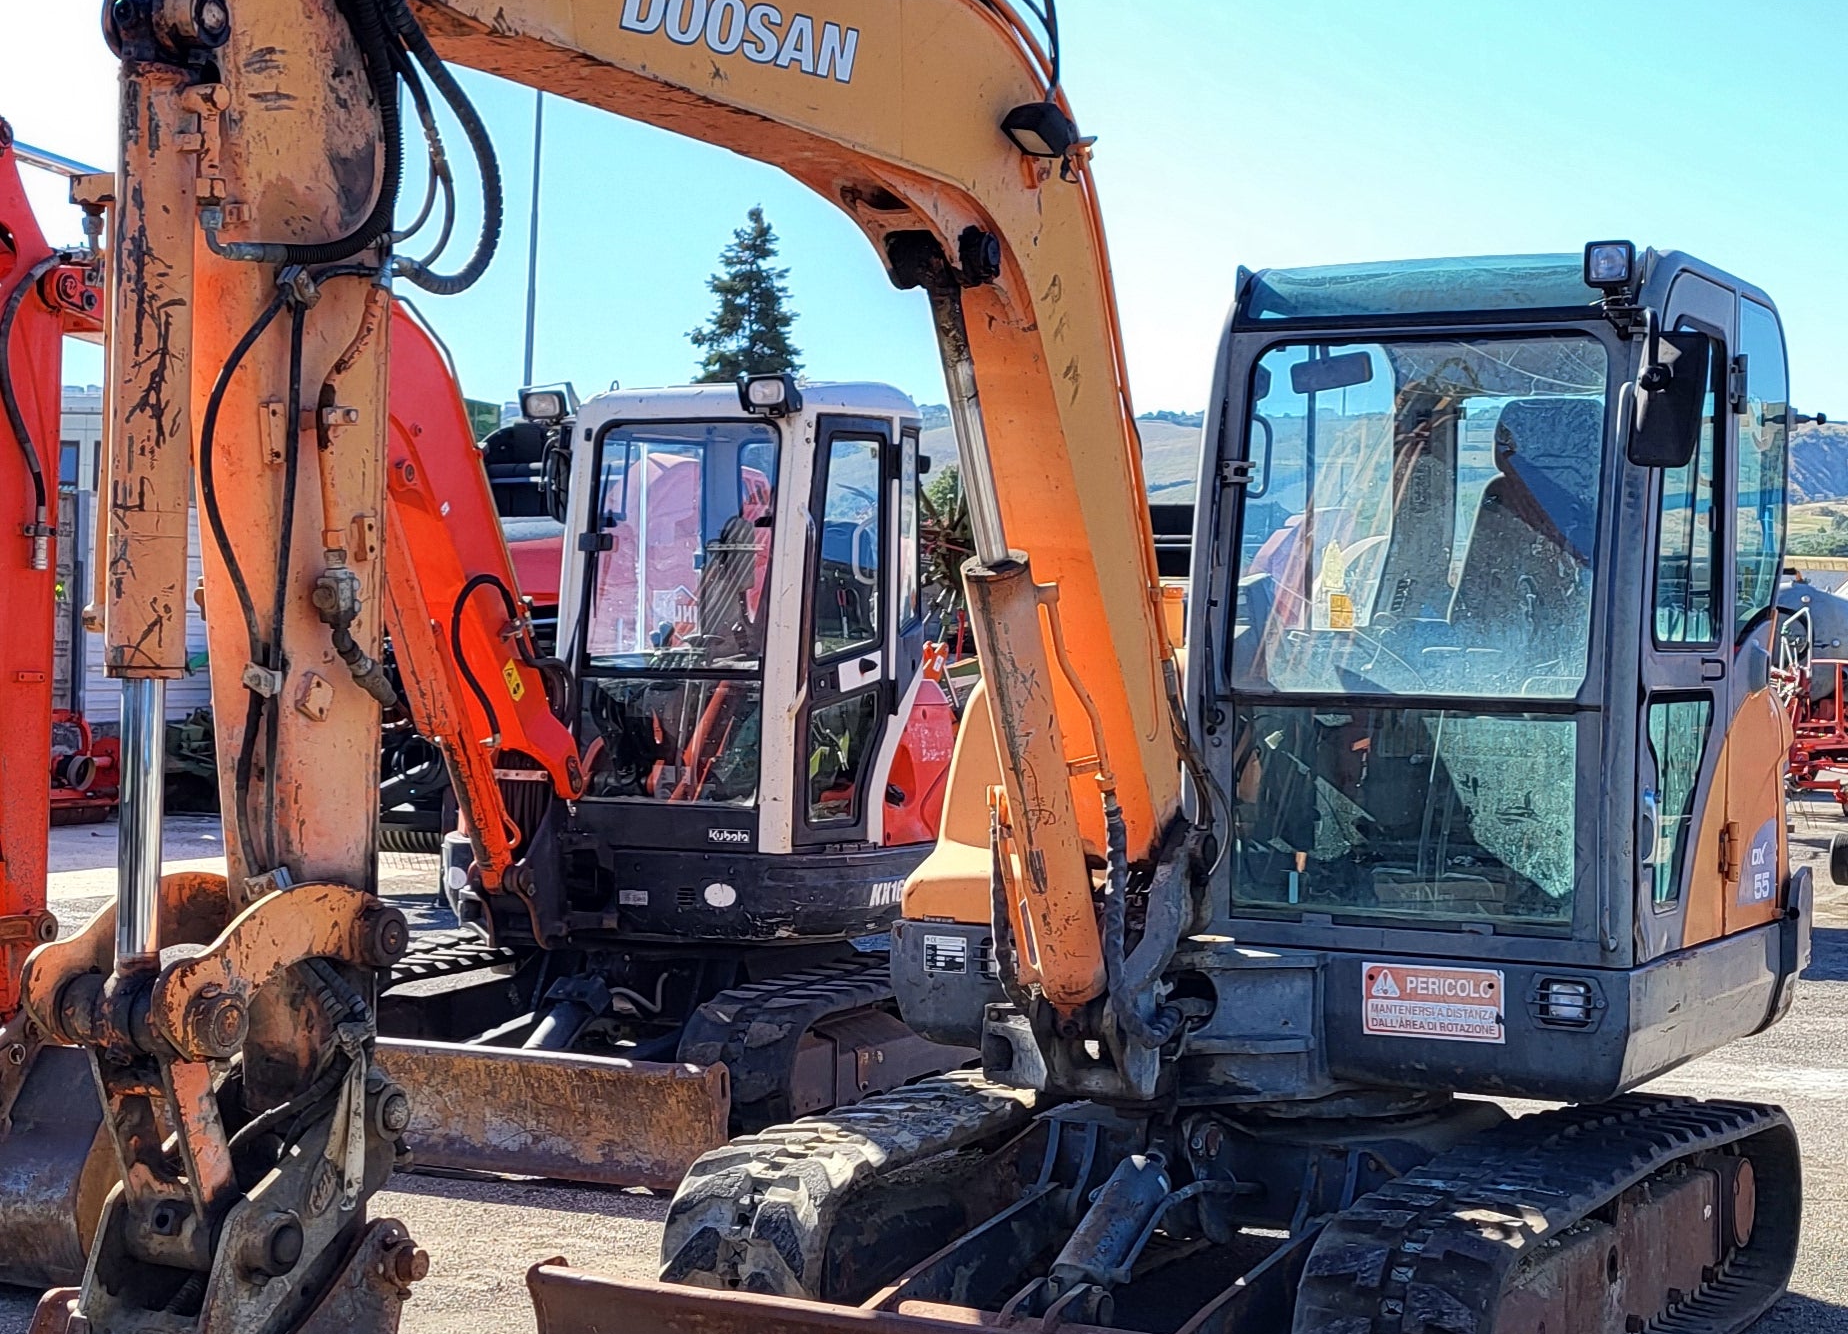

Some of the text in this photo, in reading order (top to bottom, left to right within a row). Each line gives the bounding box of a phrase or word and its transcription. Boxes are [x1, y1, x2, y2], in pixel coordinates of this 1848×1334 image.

[709, 830, 749, 842] Kubota
[1755, 872, 1770, 900] 55
[1371, 1003, 1494, 1020] MANTENERSI A DISTANZA
[1428, 1021, 1437, 1030] DI
[1439, 1022, 1496, 1035] ROTAZIONE
